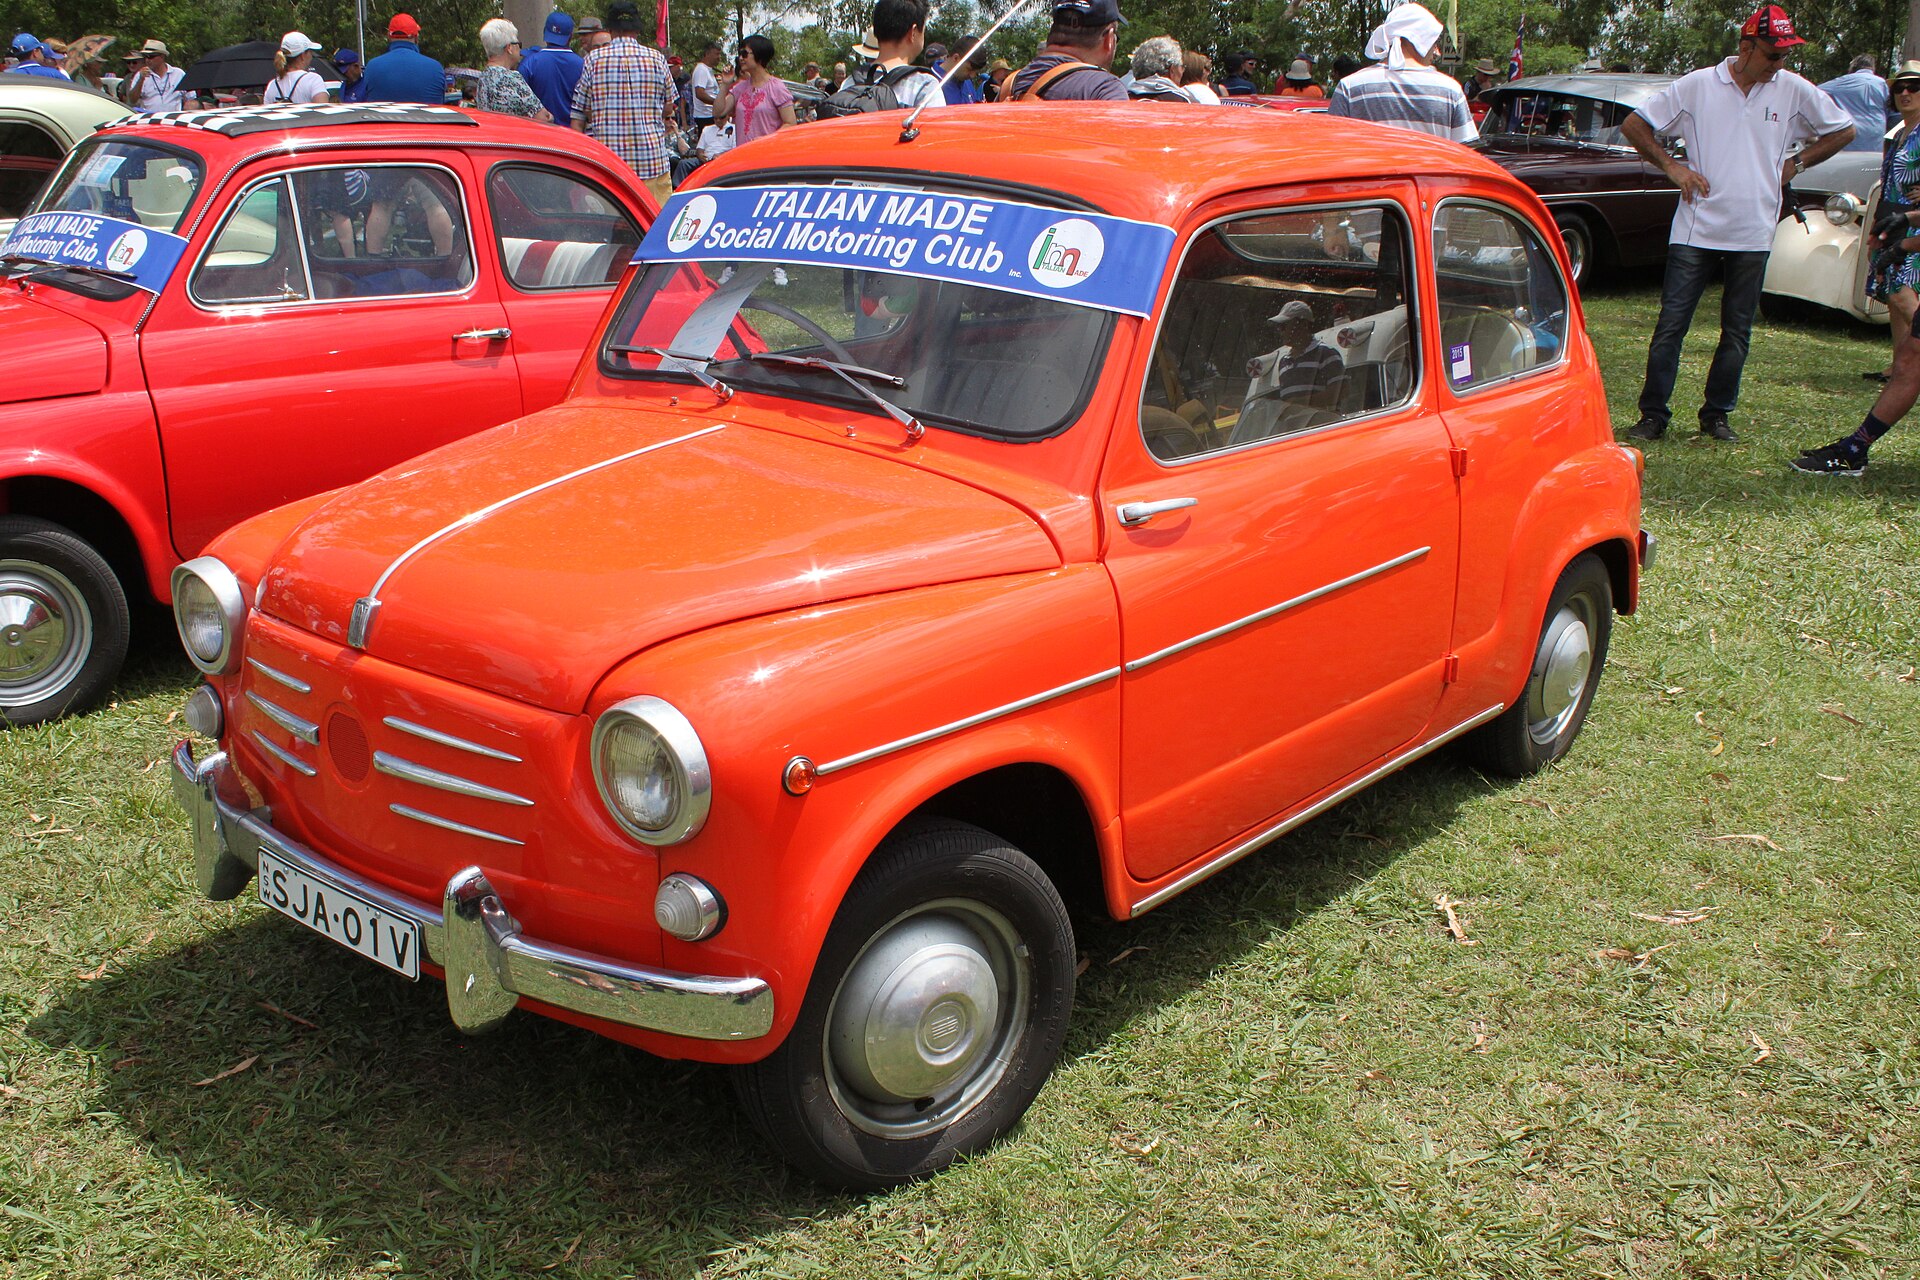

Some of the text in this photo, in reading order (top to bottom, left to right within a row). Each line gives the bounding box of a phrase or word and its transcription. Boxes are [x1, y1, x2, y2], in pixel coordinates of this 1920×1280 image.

[1446, 35, 1462, 43] OE
[752, 191, 993, 236] ITALIAN MADE
[15, 215, 104, 239] ITALIAN MADE
[15, 236, 64, 260] Motoring
[62, 239, 98, 262] Club
[704, 222, 1022, 278] Social Motoring Club Inc.
[1451, 347, 1463, 359] 2015
[262, 860, 271, 900] NSW
